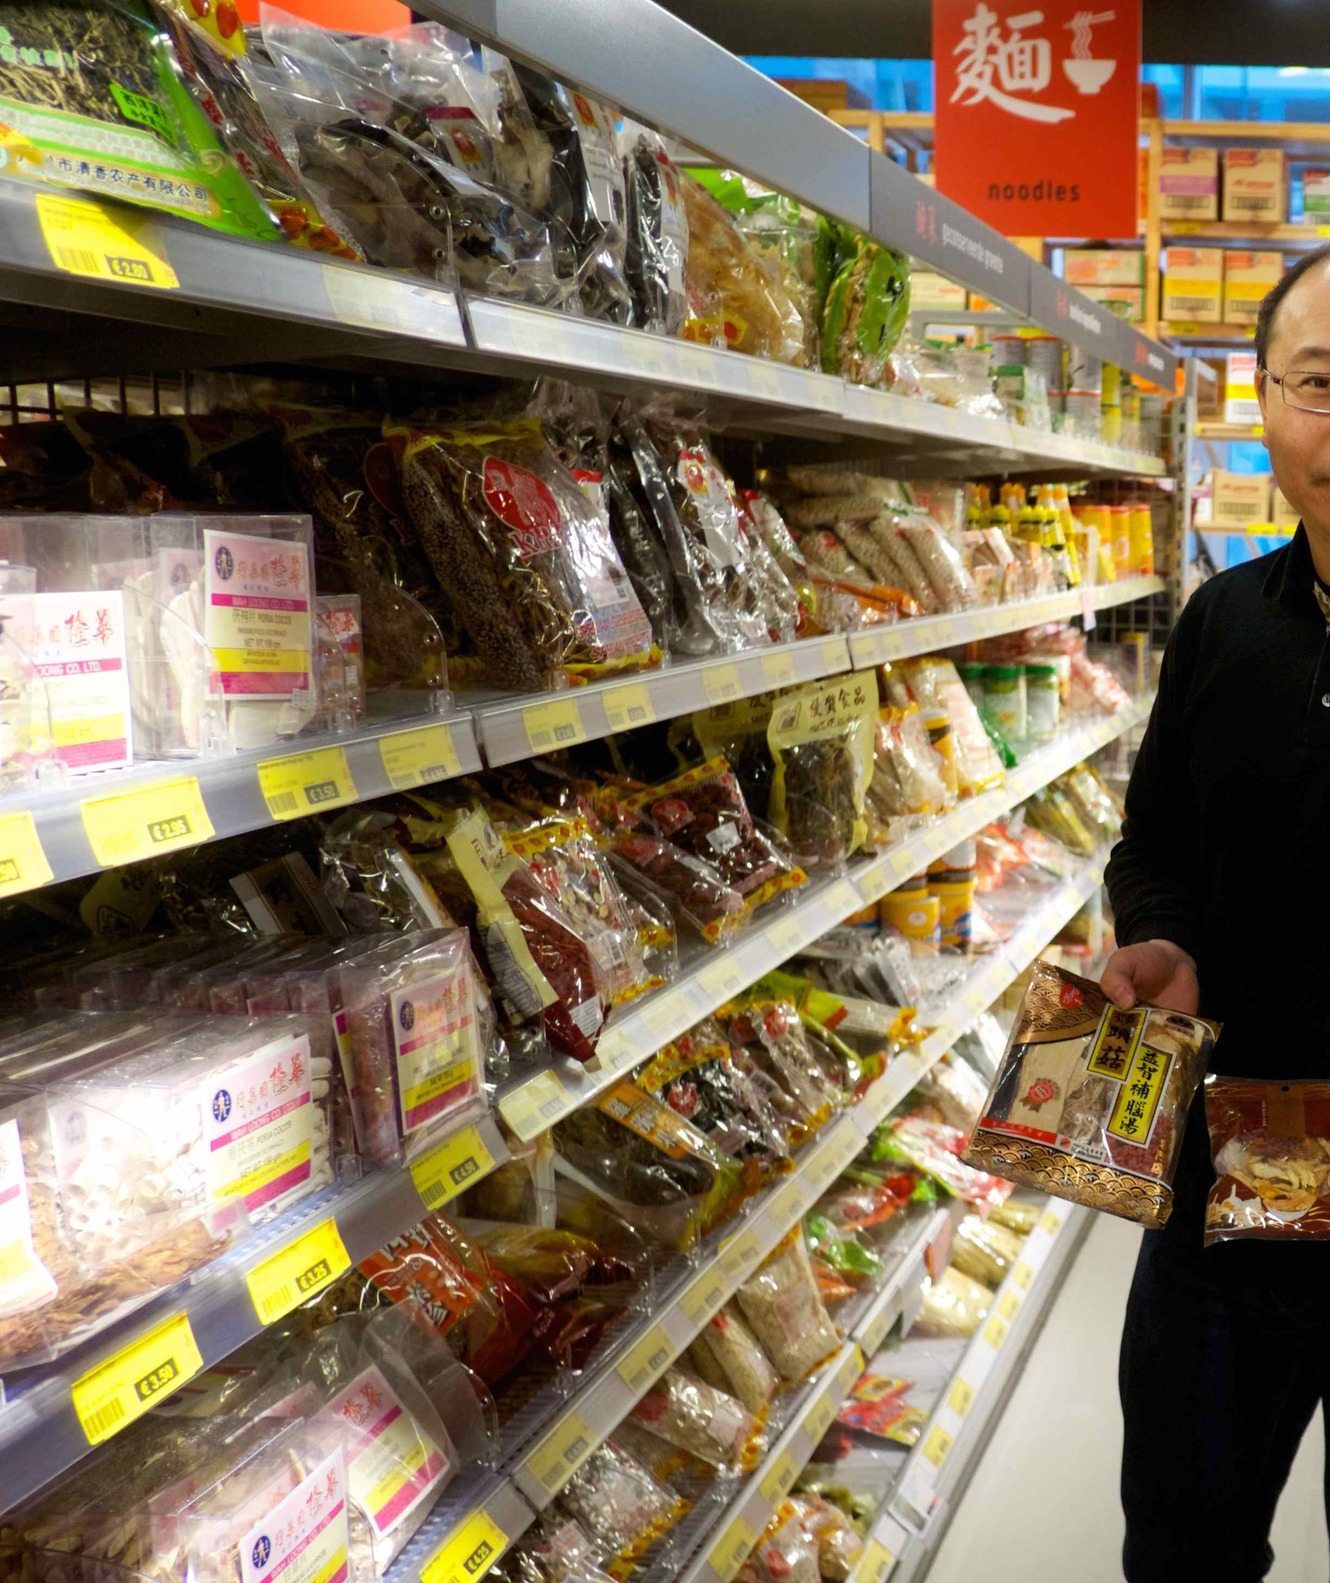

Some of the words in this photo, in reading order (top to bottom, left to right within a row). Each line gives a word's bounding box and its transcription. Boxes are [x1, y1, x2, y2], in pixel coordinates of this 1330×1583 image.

[950, 2, 1076, 124] 麵
[20, 155, 208, 200] 市清香农产有限公司
[988, 181, 1081, 202] noodles
[66, 662, 81, 675] CO.
[83, 661, 102, 673] LTD.
[308, 783, 338, 803] €3.50
[150, 818, 188, 841] €2.95
[1119, 1049, 1160, 1135] 益智補腦湯
[453, 1161, 478, 1182] €4.50
[299, 1263, 328, 1290] €3.25
[138, 1362, 176, 1397] €3.50
[466, 1544, 492, 1572] €4.25
